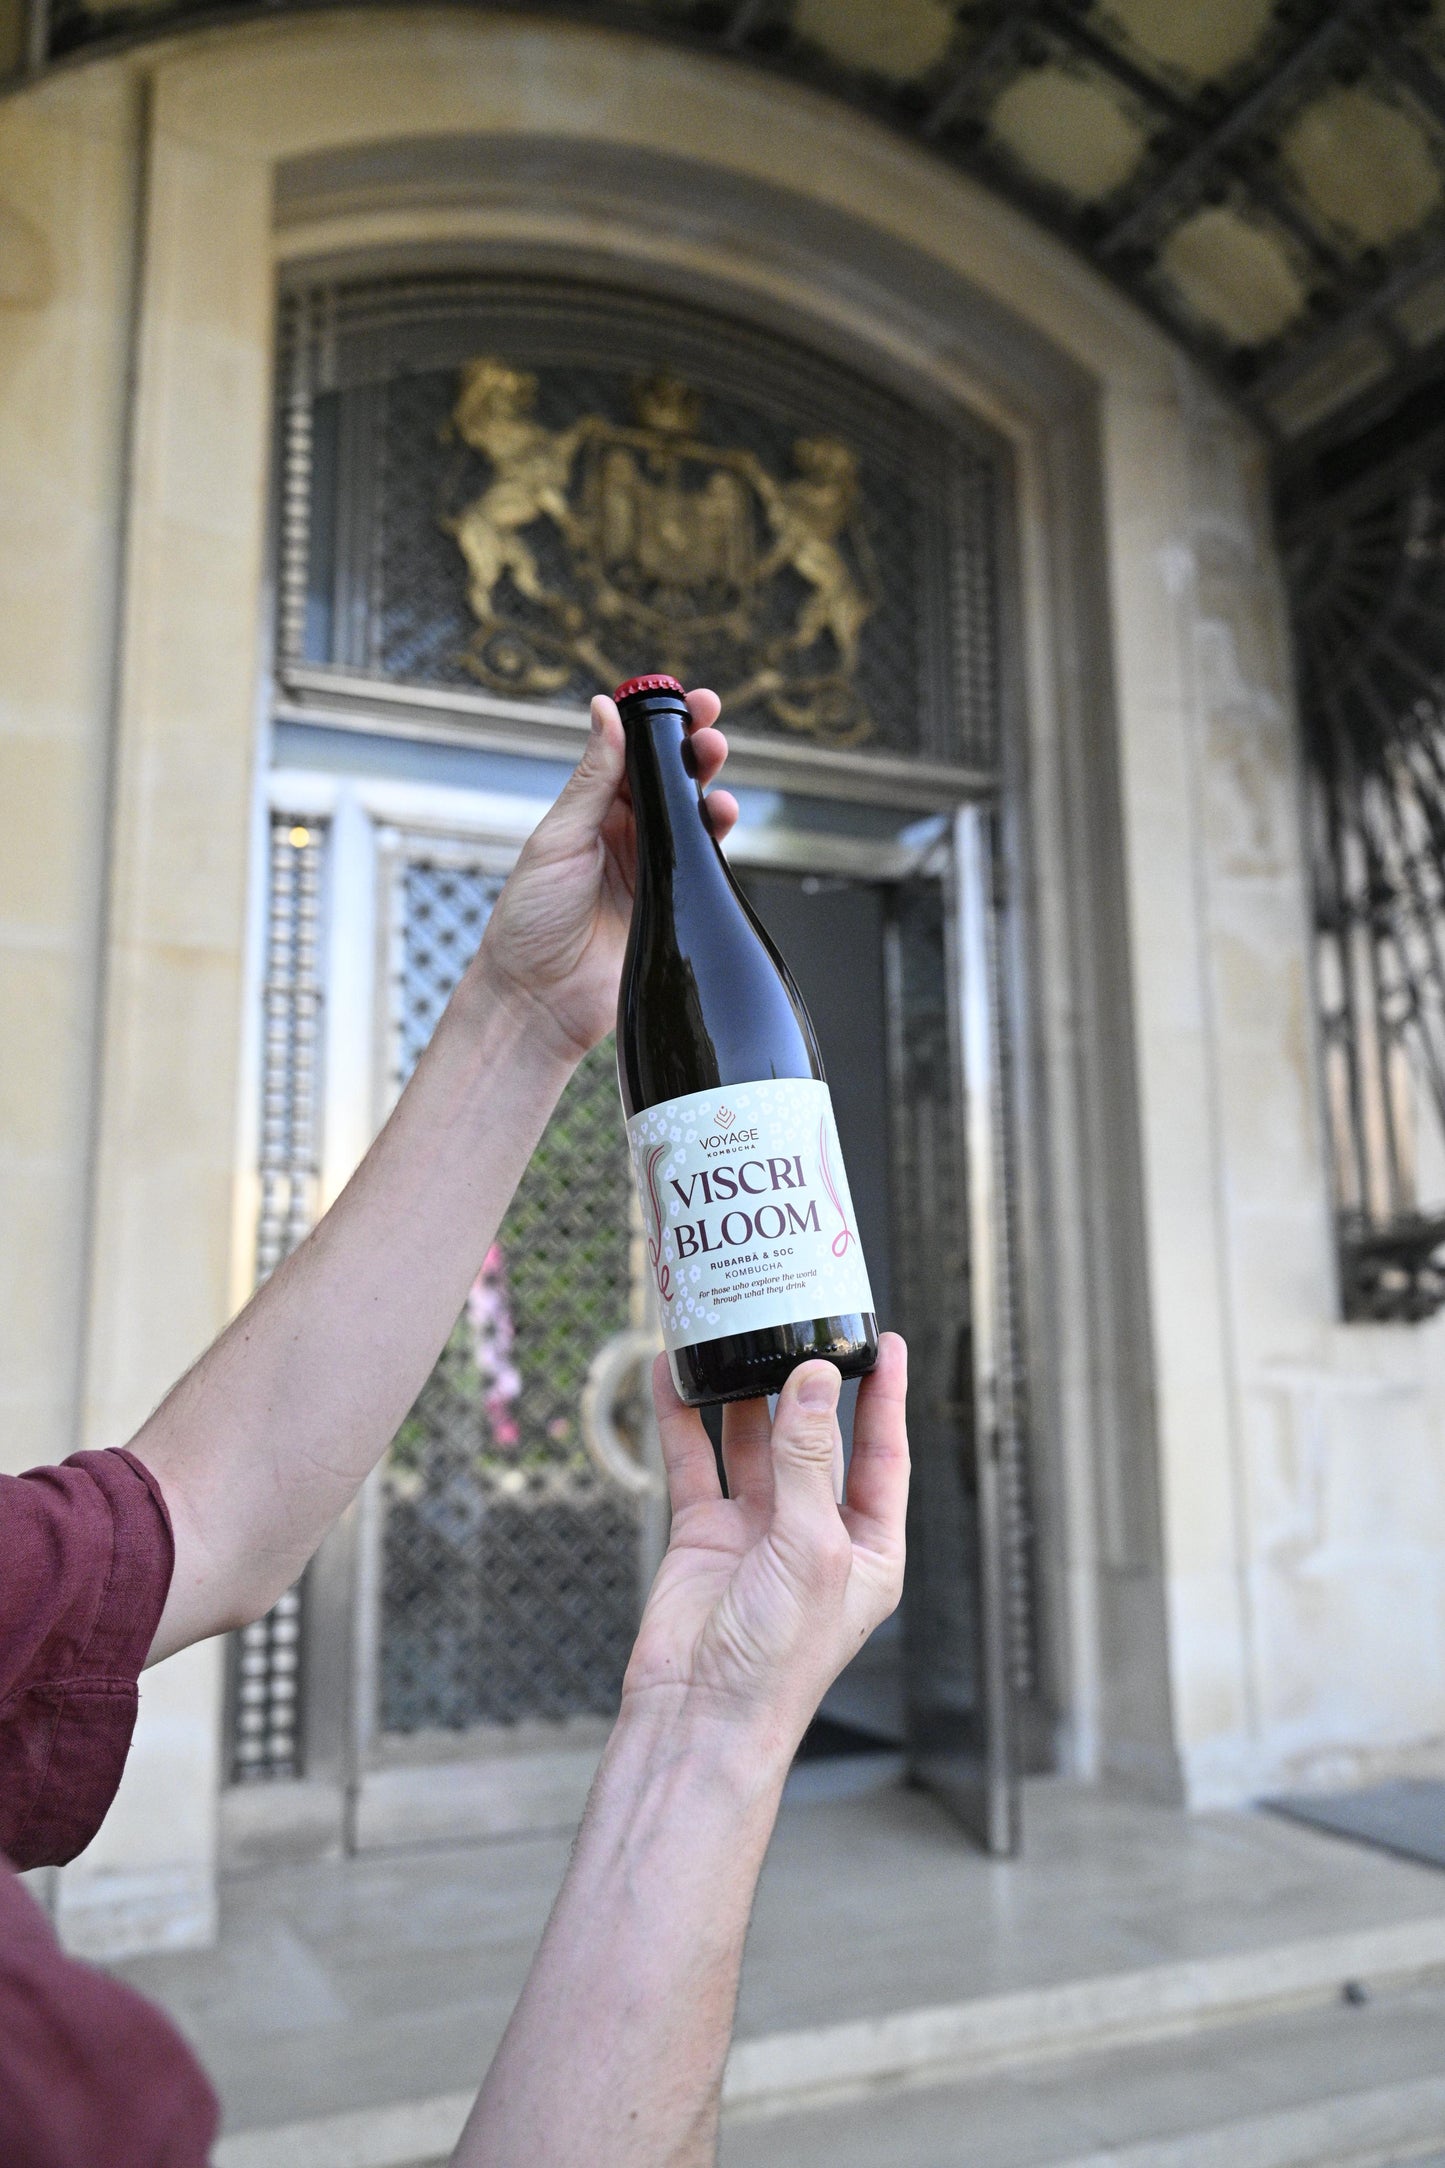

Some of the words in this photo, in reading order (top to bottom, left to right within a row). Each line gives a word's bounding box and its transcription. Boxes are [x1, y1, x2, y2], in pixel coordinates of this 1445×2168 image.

[699, 1128, 759, 1150] VOYAGE
[707, 1144, 756, 1158] KOMBUCHA
[670, 1155, 807, 1209] VISCRI
[673, 1200, 822, 1260] BLOOM
[763, 1251, 769, 1260] &
[773, 1247, 794, 1258] SOC
[725, 1261, 783, 1279] KOMBUCHA
[711, 1286, 731, 1296] those
[732, 1281, 750, 1291] who
[751, 1276, 780, 1288] explore
[782, 1273, 795, 1281] the
[796, 1269, 817, 1279] world
[713, 1292, 742, 1305] through
[744, 1287, 764, 1299] what
[766, 1284, 784, 1295] they
[785, 1280, 806, 1291] drink
